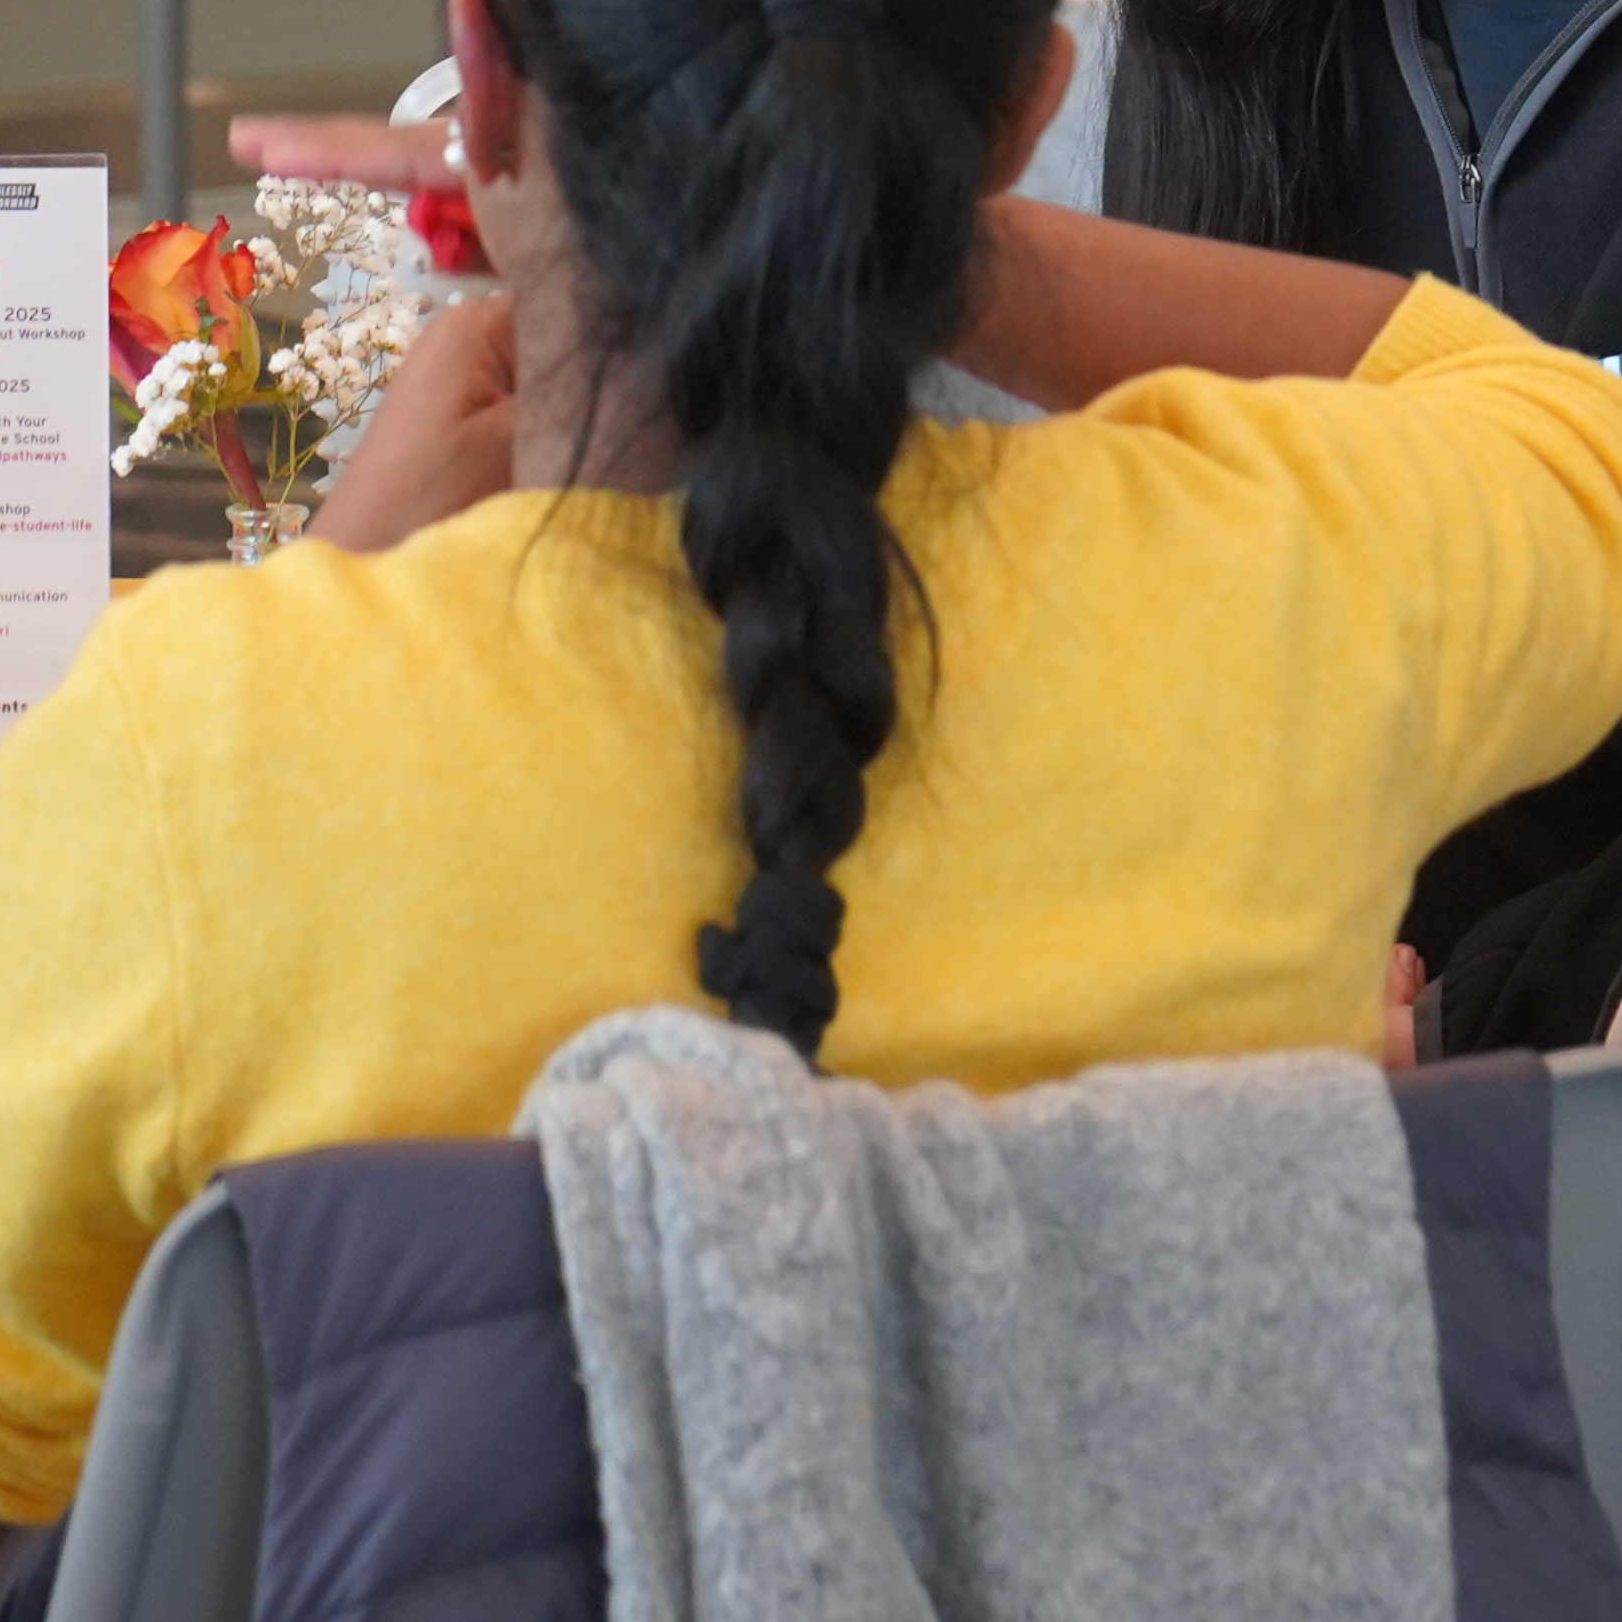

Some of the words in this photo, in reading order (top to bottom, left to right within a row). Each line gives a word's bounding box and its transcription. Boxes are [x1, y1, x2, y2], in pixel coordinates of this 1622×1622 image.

[3, 307, 52, 322] 2025
[17, 328, 86, 341] Workshop
[15, 415, 48, 428] Your
[14, 433, 60, 444] School
